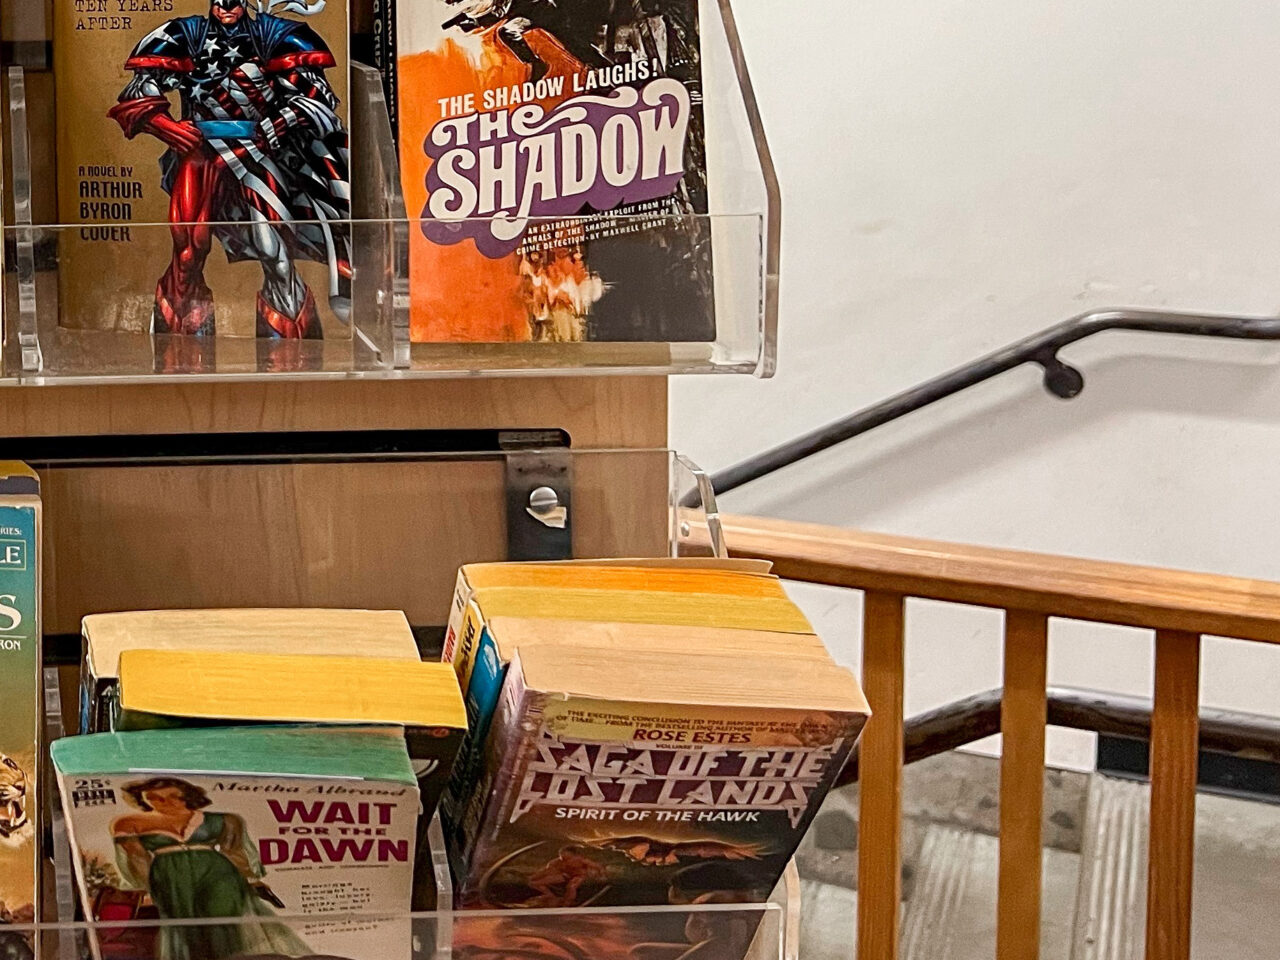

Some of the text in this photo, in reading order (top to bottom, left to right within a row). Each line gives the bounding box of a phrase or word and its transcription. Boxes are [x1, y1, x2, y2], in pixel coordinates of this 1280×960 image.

[75, 0, 108, 12] TEN
[75, 16, 132, 30] AFTER
[373, 18, 383, 67] Cruz
[438, 58, 659, 118] THE SHADOW LAUGHS!
[429, 78, 690, 240] SHADOW
[78, 166, 133, 177] A NOVEL BY
[79, 181, 143, 198] ARTHUR
[80, 202, 132, 220] BYRON
[528, 197, 676, 235] AN FROM THE
[80, 223, 132, 242] COVER
[516, 244, 541, 255] CRIME
[543, 236, 585, 251] DETECTION
[590, 233, 599, 241] BY
[602, 224, 640, 238] MAXWELL
[522, 220, 617, 245] ANNALS OF THE SHADOW
[587, 711, 630, 721] EXCITING
[631, 715, 690, 725] CONCLUSION
[633, 728, 752, 744] ROSE ESTES
[655, 723, 712, 732] BESTSELLING
[528, 738, 838, 781] SAGA OF THE
[214, 782, 407, 797] Martha Albrand
[514, 771, 818, 815] LOST LANDS
[267, 799, 397, 825] WAIT
[554, 807, 761, 823] SPIRIT OF THE HAWK
[278, 826, 387, 836] FOR THE
[258, 838, 409, 865] DAWN
